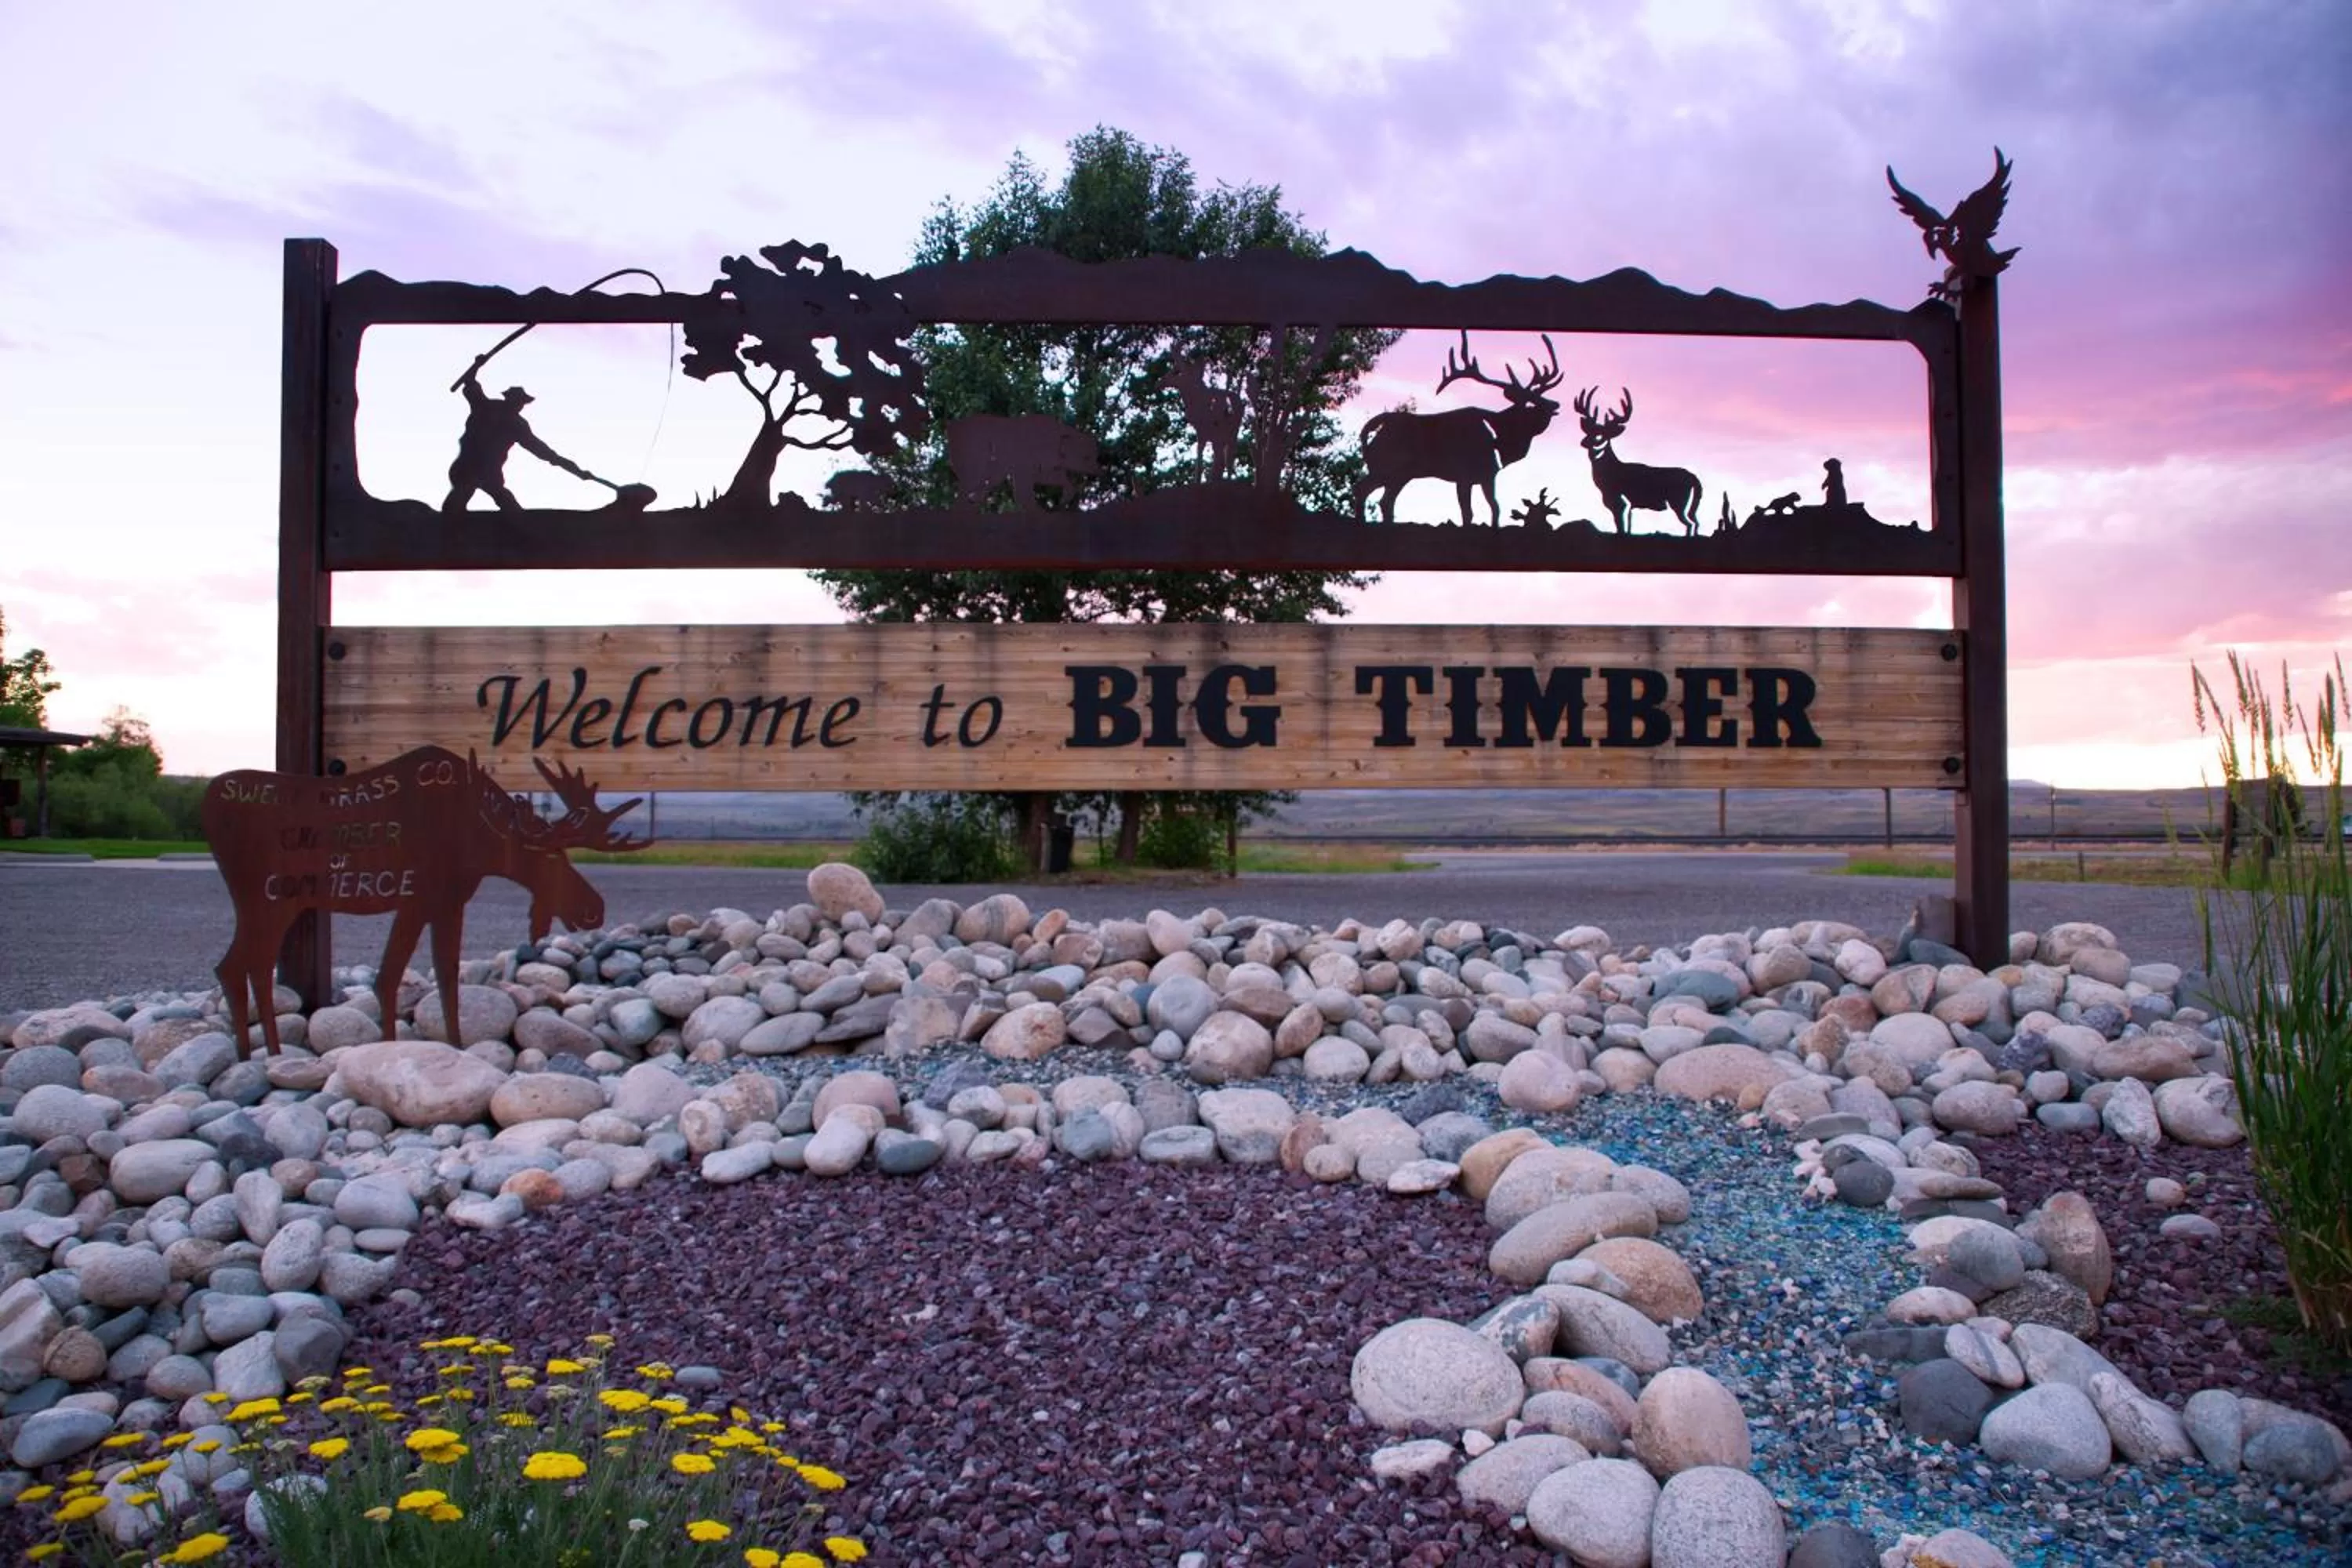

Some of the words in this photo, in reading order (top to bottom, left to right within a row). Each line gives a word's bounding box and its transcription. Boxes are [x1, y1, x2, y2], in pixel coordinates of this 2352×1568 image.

[476, 666, 860, 750] Welcome
[920, 684, 1003, 748] to
[1065, 665, 1281, 749] BIG
[1355, 665, 1822, 749] TIMBER
